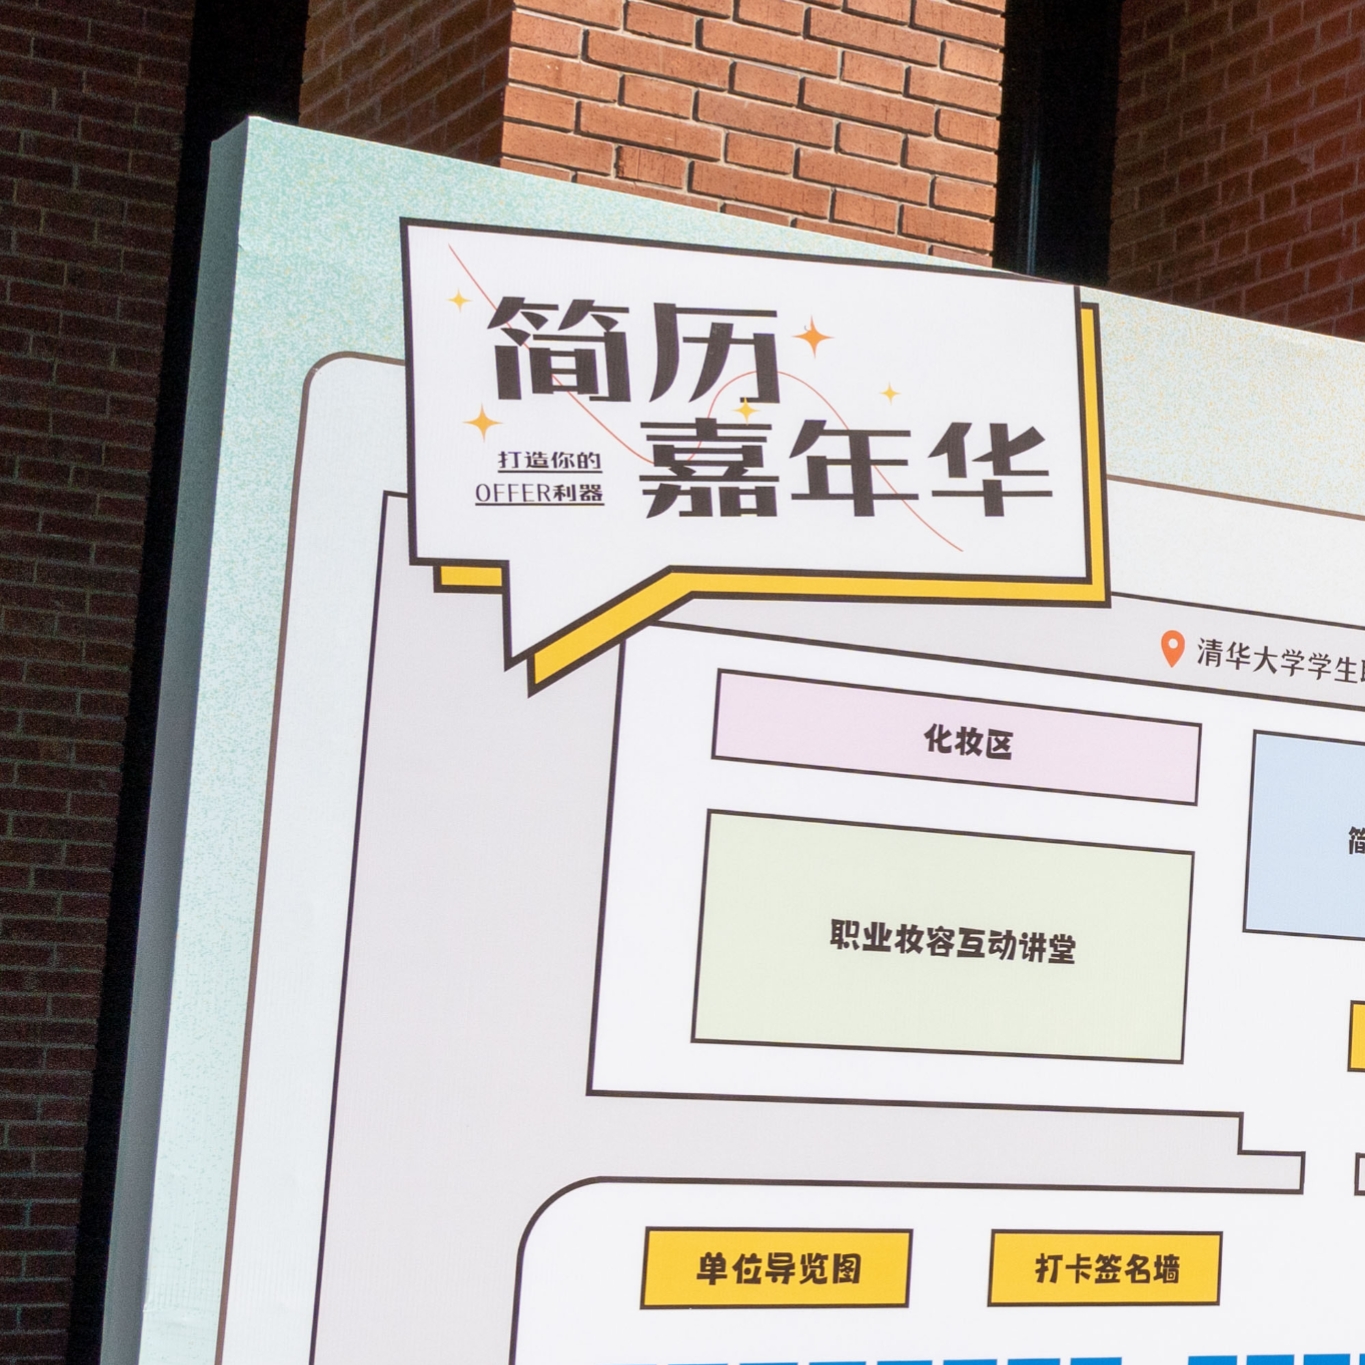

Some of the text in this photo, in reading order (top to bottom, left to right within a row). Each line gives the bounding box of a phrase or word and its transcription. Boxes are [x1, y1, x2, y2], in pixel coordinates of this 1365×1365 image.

[487, 296, 781, 404] 简历
[498, 450, 602, 471] 打造你的
[641, 417, 1054, 519] 嘉年华
[475, 482, 605, 504] OFFER利器
[924, 723, 1014, 761] 化妆区
[829, 917, 1077, 965] 职业妆容互动讲堂
[695, 1250, 862, 1288] 单位导览图
[1034, 1252, 1181, 1286] 打卡签名墙
